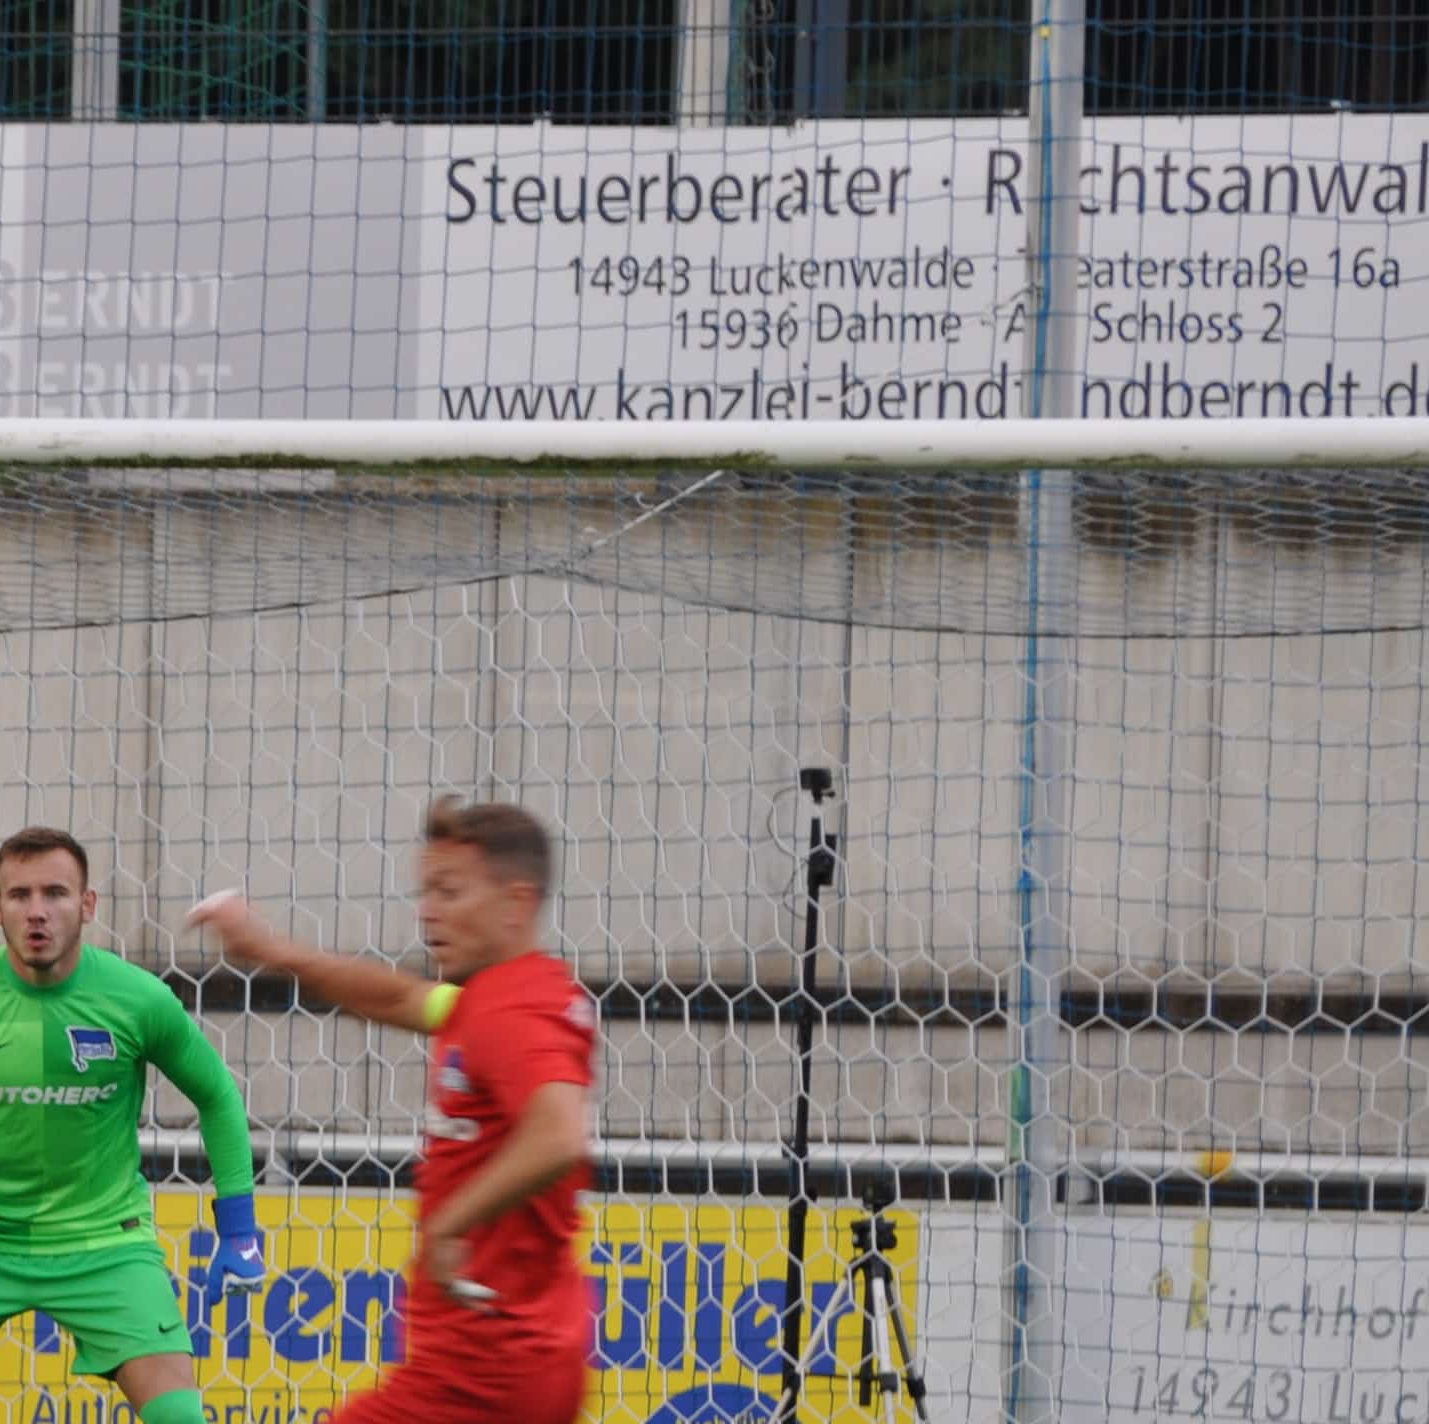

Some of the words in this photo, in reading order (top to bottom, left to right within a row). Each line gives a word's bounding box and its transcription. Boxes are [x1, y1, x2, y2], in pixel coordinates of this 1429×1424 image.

[445, 151, 911, 224] Steuerberater
[985, 141, 1428, 217] Rchtsanwal
[568, 255, 691, 297] 14943
[709, 244, 975, 296] Luckenwalde
[1017, 244, 1309, 289] eaterstraße
[1327, 246, 1401, 290] 16a
[675, 303, 799, 350] 15936
[816, 300, 963, 344] Dahme
[1003, 302, 1027, 343] A
[1092, 300, 1244, 344] Schloss
[1260, 301, 1284, 343] 2
[587, 1241, 855, 1376] üller
[1133, 1366, 1294, 1423] 14943
